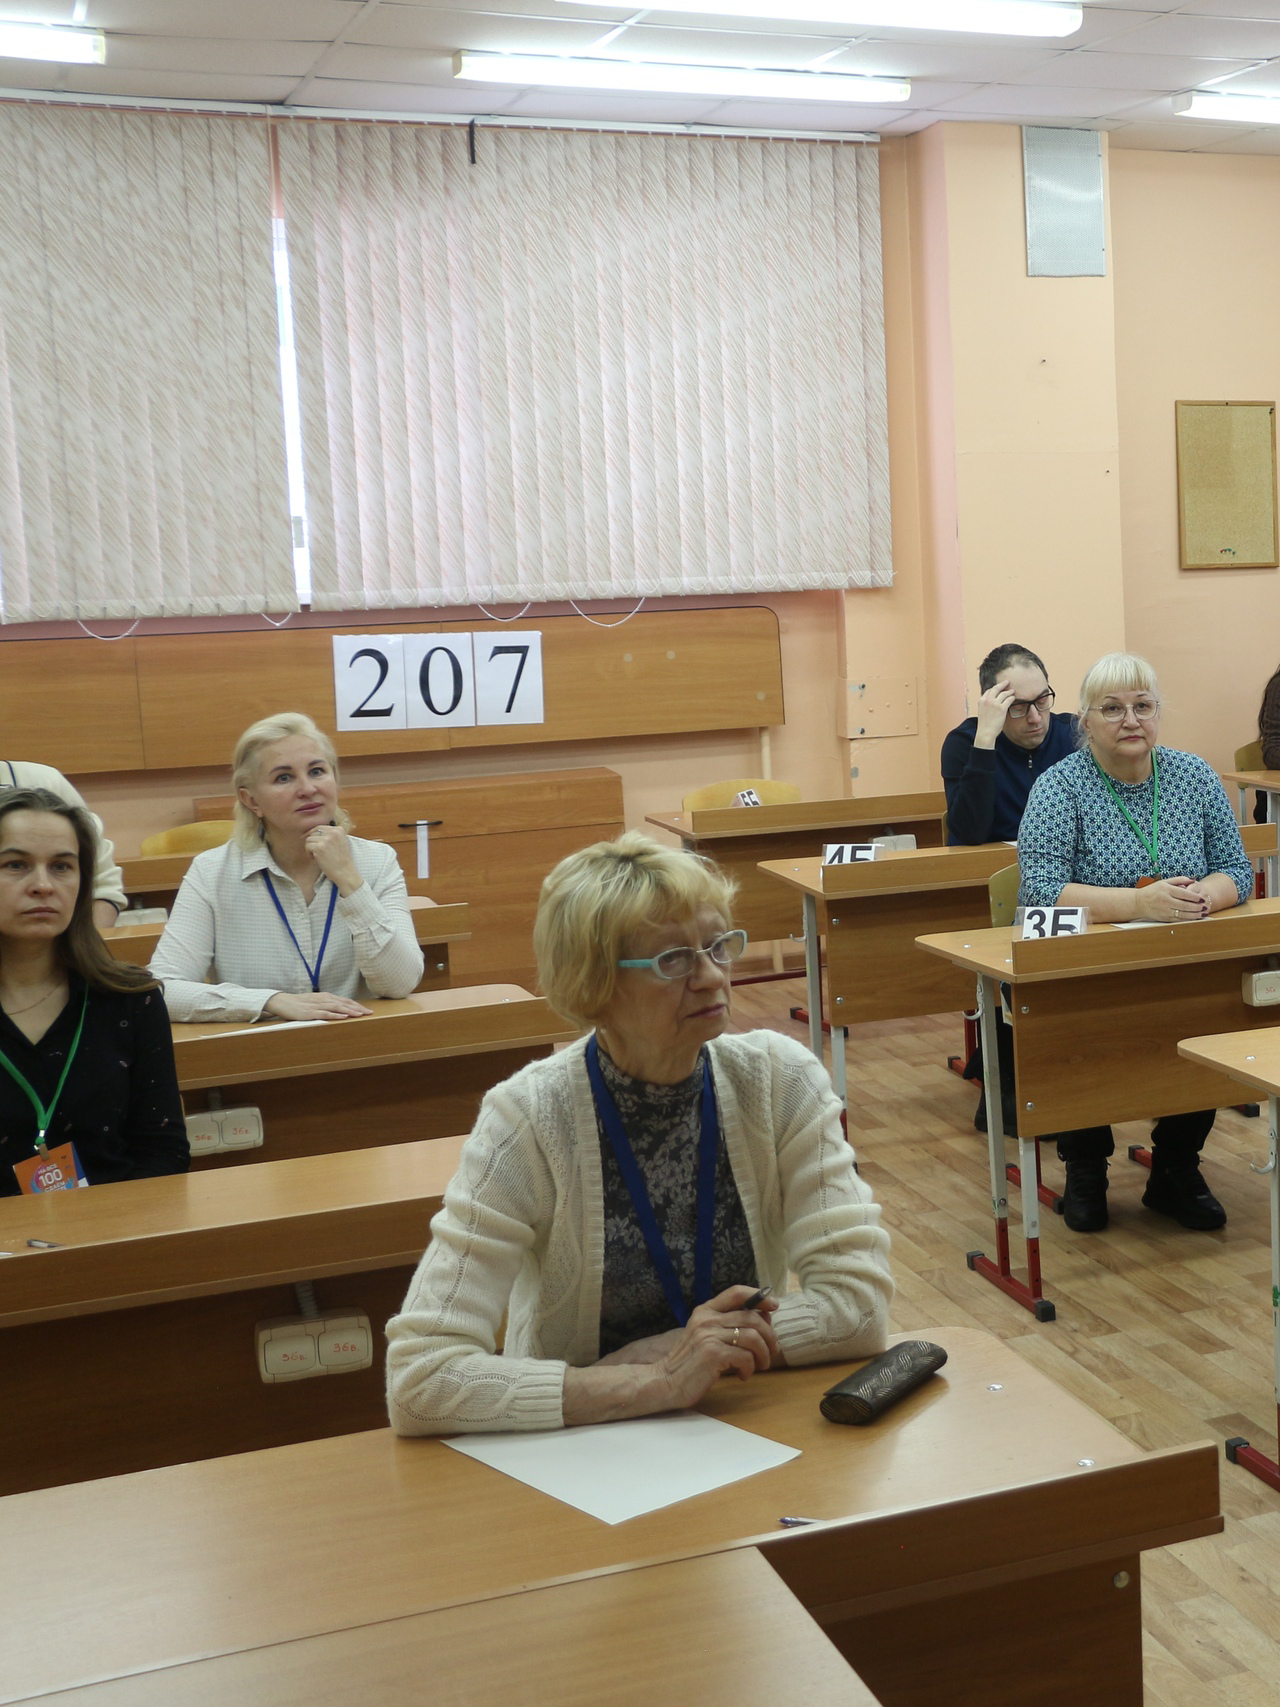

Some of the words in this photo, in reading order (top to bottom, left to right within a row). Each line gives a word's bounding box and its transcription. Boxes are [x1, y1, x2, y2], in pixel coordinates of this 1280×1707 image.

[348, 645, 530, 718] 207
[1024, 908, 1078, 940] 3Б
[38, 1168, 63, 1187] 100
